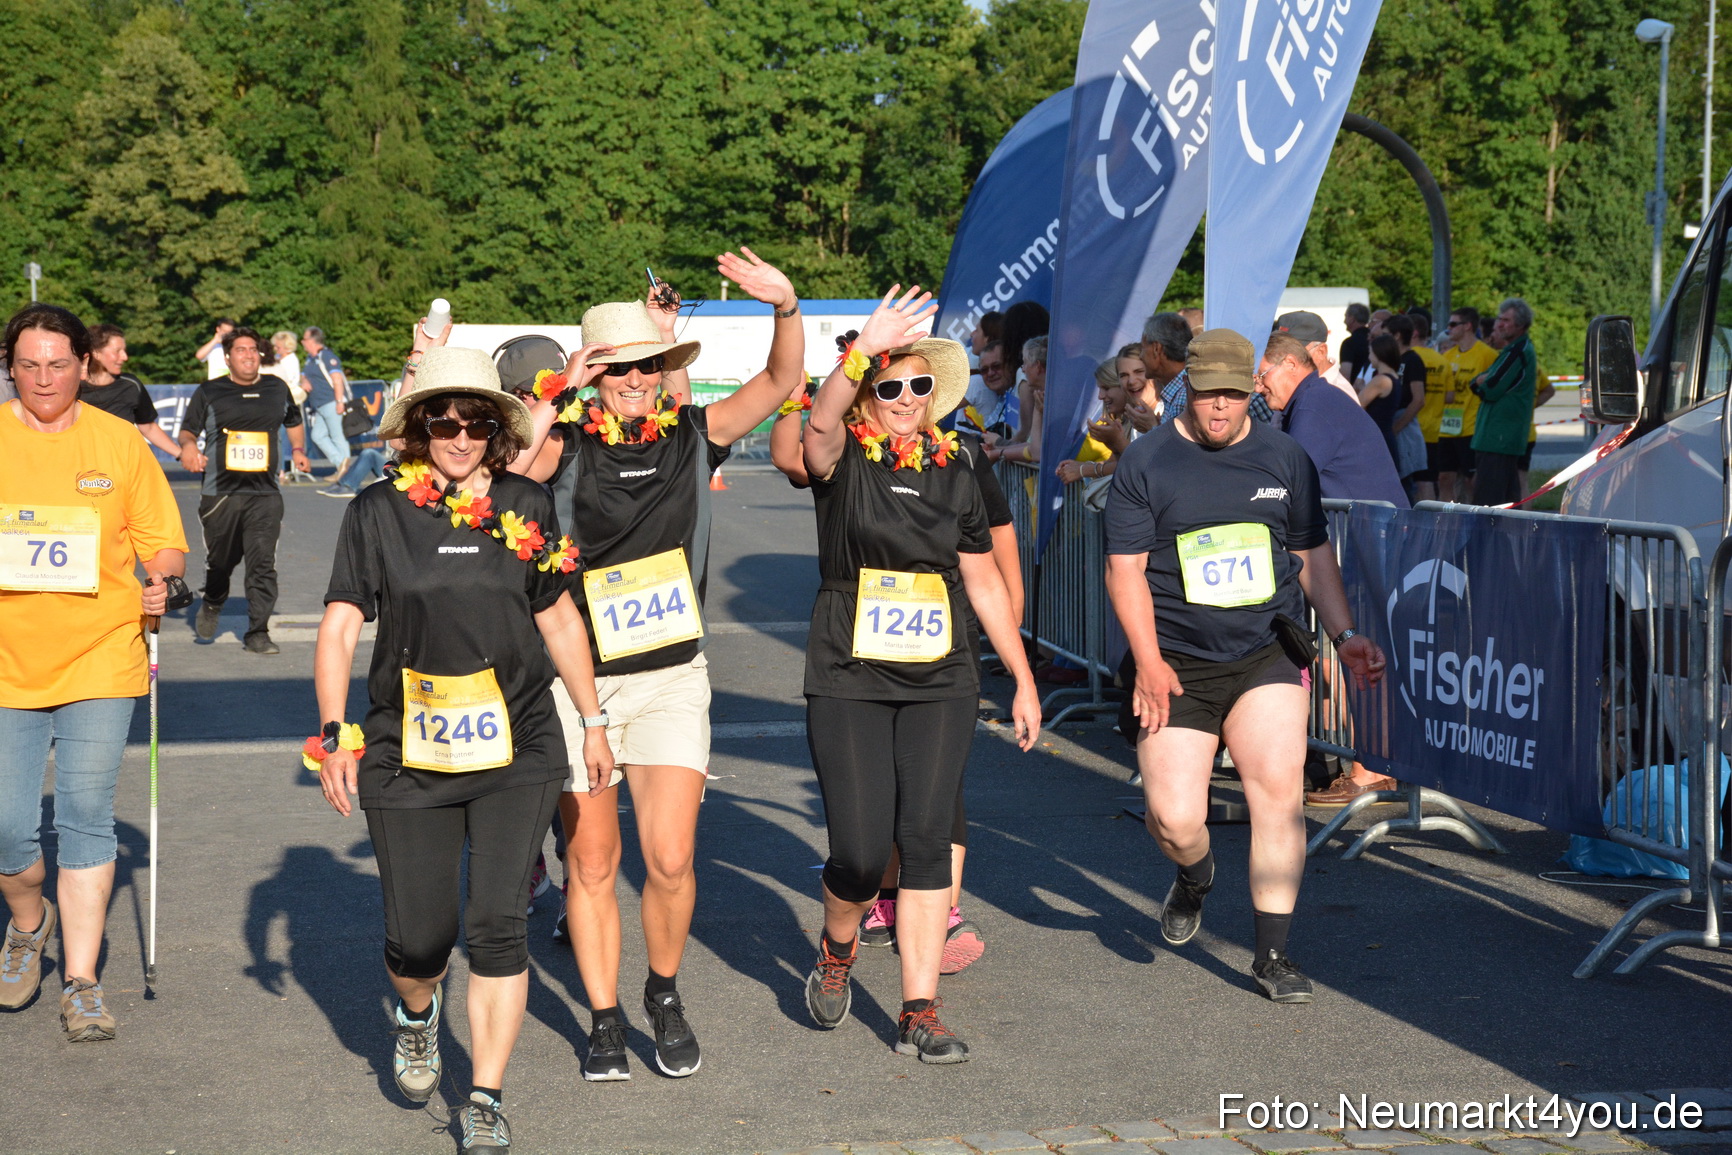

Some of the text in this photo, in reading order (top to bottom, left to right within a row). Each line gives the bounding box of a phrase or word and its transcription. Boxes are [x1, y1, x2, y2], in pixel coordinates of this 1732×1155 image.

[1131, 0, 1216, 176] Fisc
[231, 447, 264, 460] 1198
[2, 528, 30, 536] walken
[27, 540, 68, 567] 76
[601, 577, 637, 591] firmenlauf
[1202, 555, 1254, 586] 671
[593, 592, 622, 603] walken
[603, 587, 687, 632] 1244
[867, 606, 944, 637] 1245
[1408, 628, 1544, 722] Fischer
[413, 711, 499, 745] 1246
[1424, 717, 1537, 770] AUTOMOBILE
